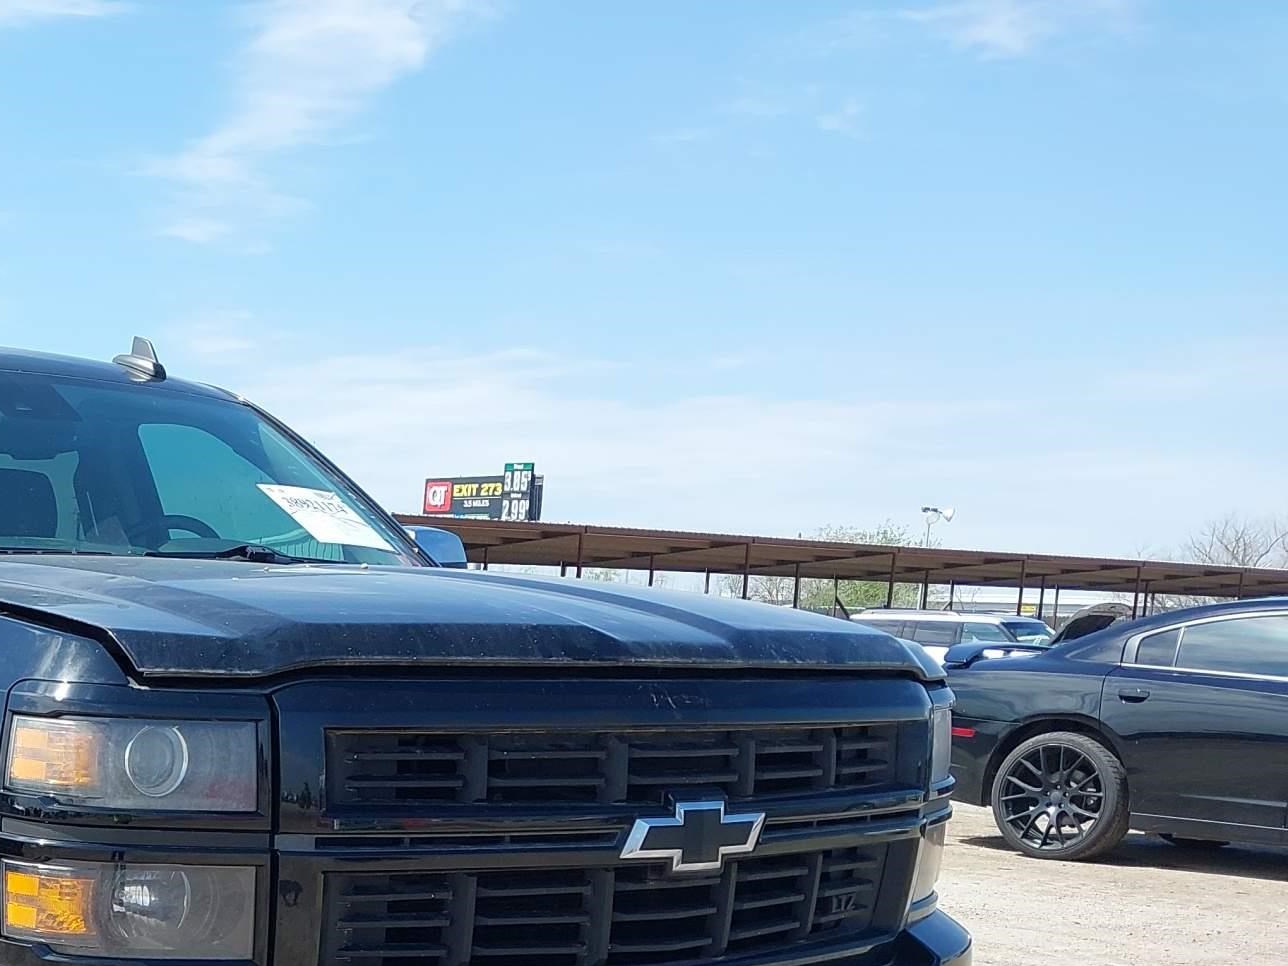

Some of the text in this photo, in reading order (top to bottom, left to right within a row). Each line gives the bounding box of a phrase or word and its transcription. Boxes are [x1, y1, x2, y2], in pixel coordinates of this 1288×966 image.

[454, 484, 479, 497] EXIT
[480, 482, 502, 496] 273
[831, 894, 856, 913] LTZ
